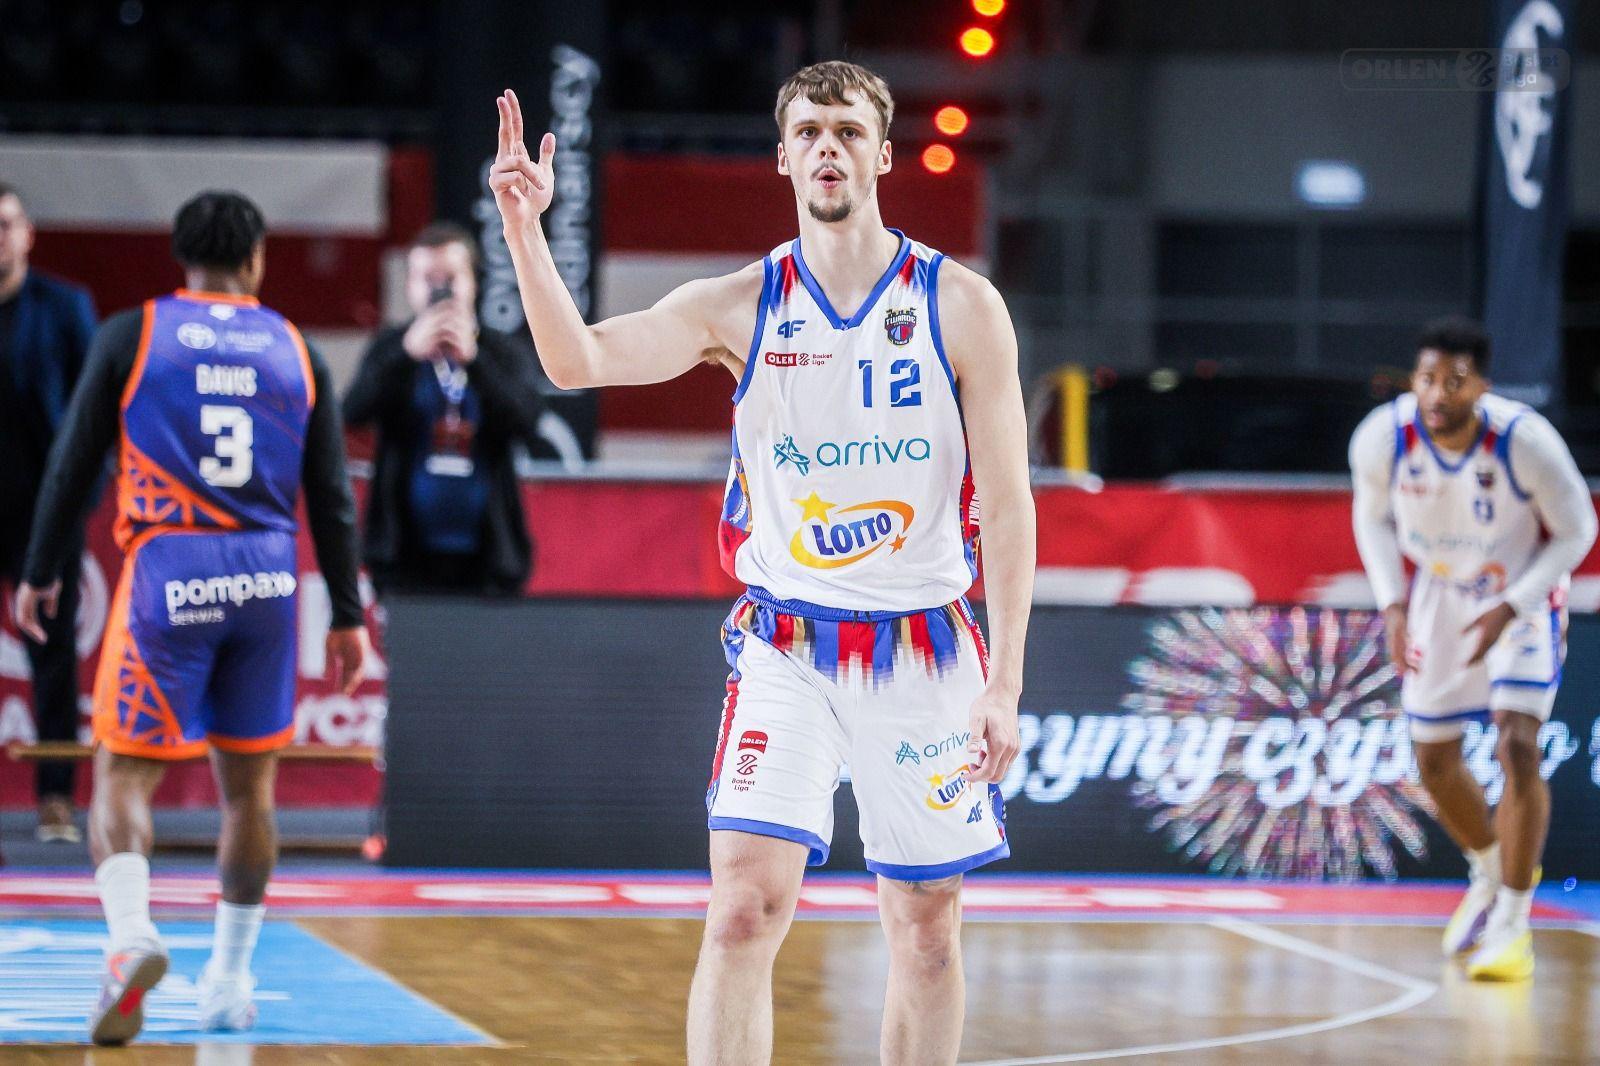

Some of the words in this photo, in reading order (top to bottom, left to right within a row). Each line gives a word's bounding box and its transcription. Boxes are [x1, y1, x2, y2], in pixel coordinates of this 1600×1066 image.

[777, 319, 806, 339] 4F
[767, 354, 794, 365] OLEN
[195, 363, 257, 397] DAVIS
[858, 358, 922, 408] 12
[199, 404, 254, 488] 3
[816, 435, 931, 467] arriva
[811, 512, 892, 556] LOTTO
[741, 737, 767, 746] ORLEN
[731, 778, 756, 786] Basket
[937, 772, 967, 804] LOTT
[966, 800, 983, 824] 4F
